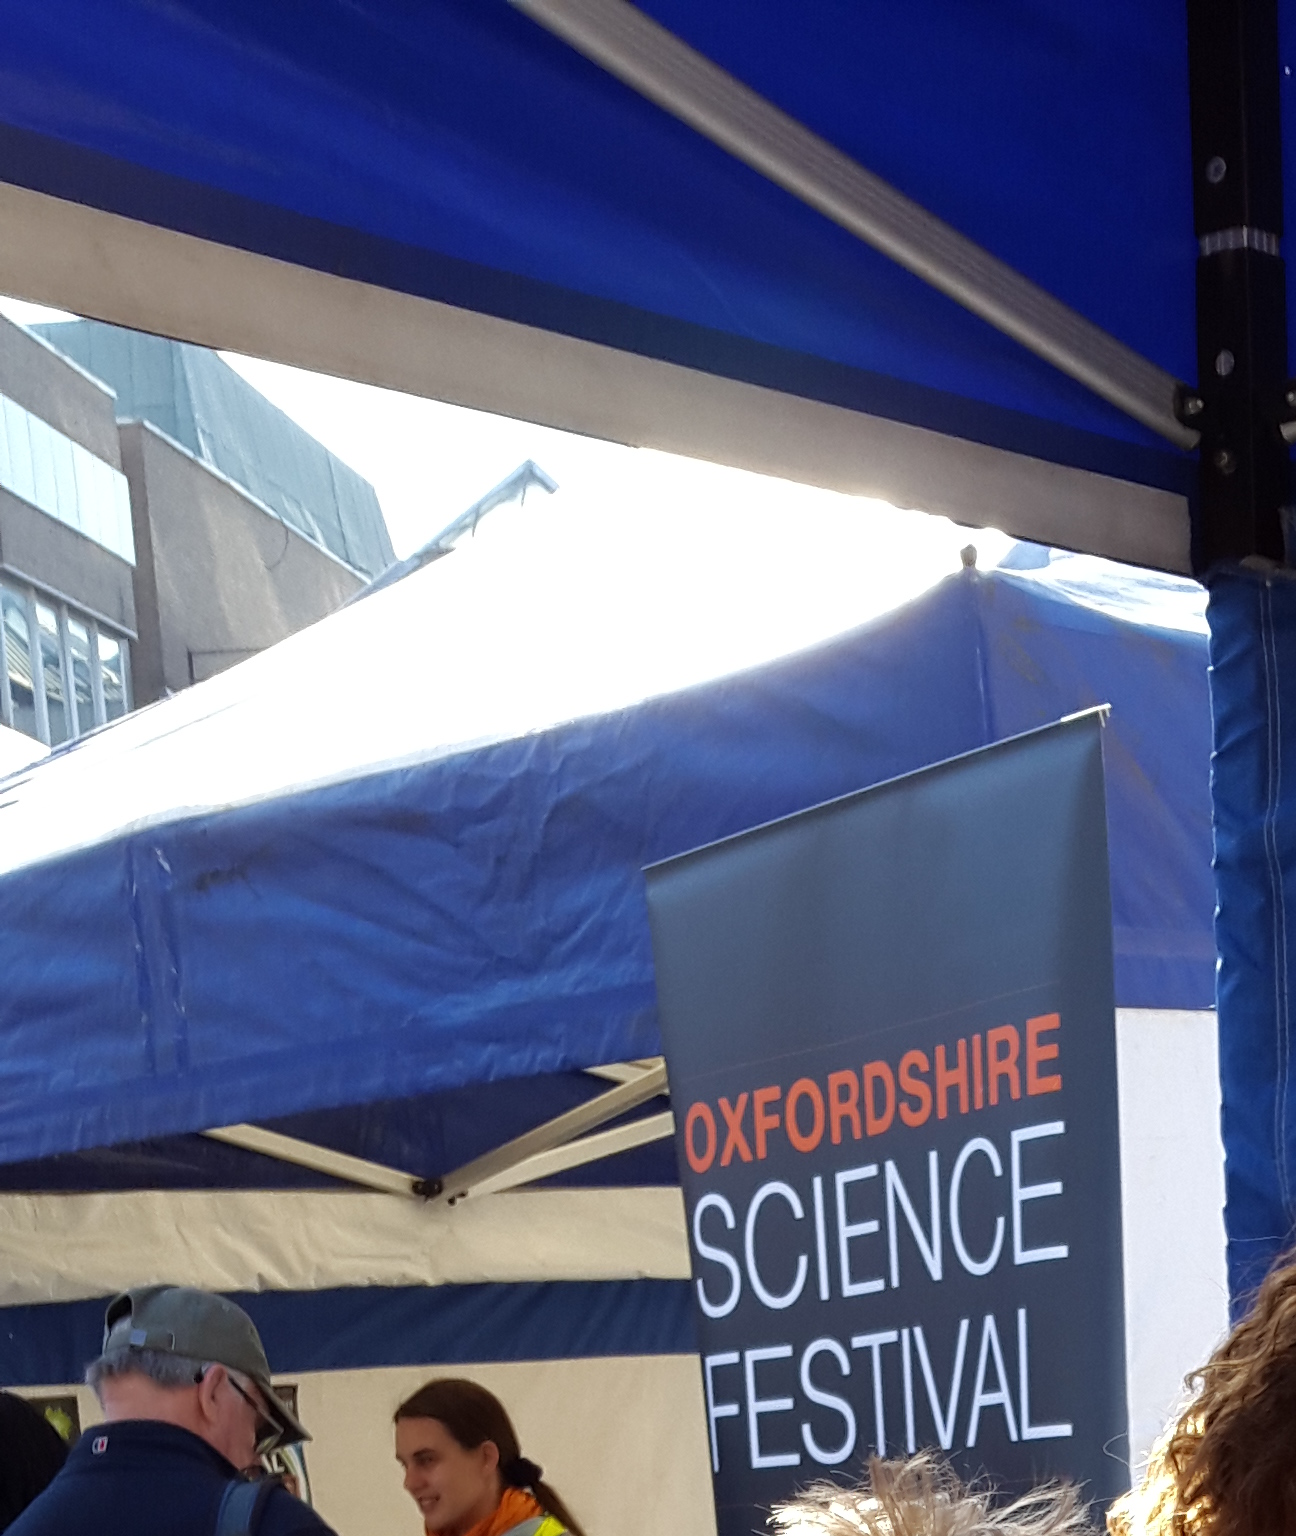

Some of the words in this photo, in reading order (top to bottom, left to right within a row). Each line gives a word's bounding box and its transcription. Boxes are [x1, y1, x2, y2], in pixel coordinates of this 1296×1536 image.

[684, 1012, 1062, 1173] OXFORDSHIRE
[693, 1121, 1069, 1318] SCIENCE
[704, 1308, 1073, 1473] FESTIVAL
